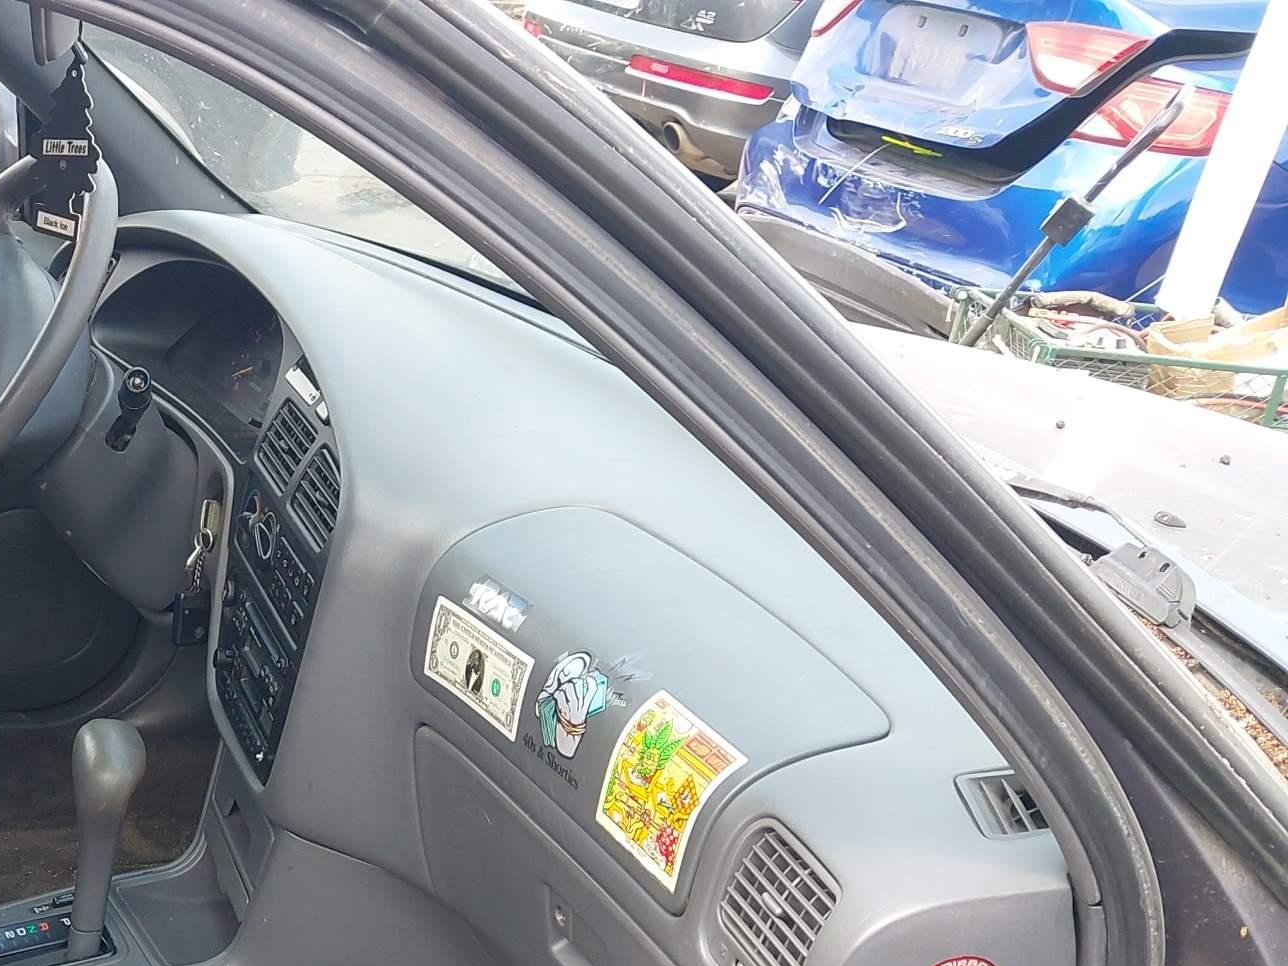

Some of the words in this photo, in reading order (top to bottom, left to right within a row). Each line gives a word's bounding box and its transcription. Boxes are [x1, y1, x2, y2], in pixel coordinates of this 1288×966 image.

[45, 140, 65, 154] Little
[67, 141, 87, 155] Trees
[43, 215, 58, 229] Black
[59, 220, 69, 232] Ice
[545, 751, 579, 791] Shorties
[15, 927, 27, 936] D
[28, 925, 38, 934] N
